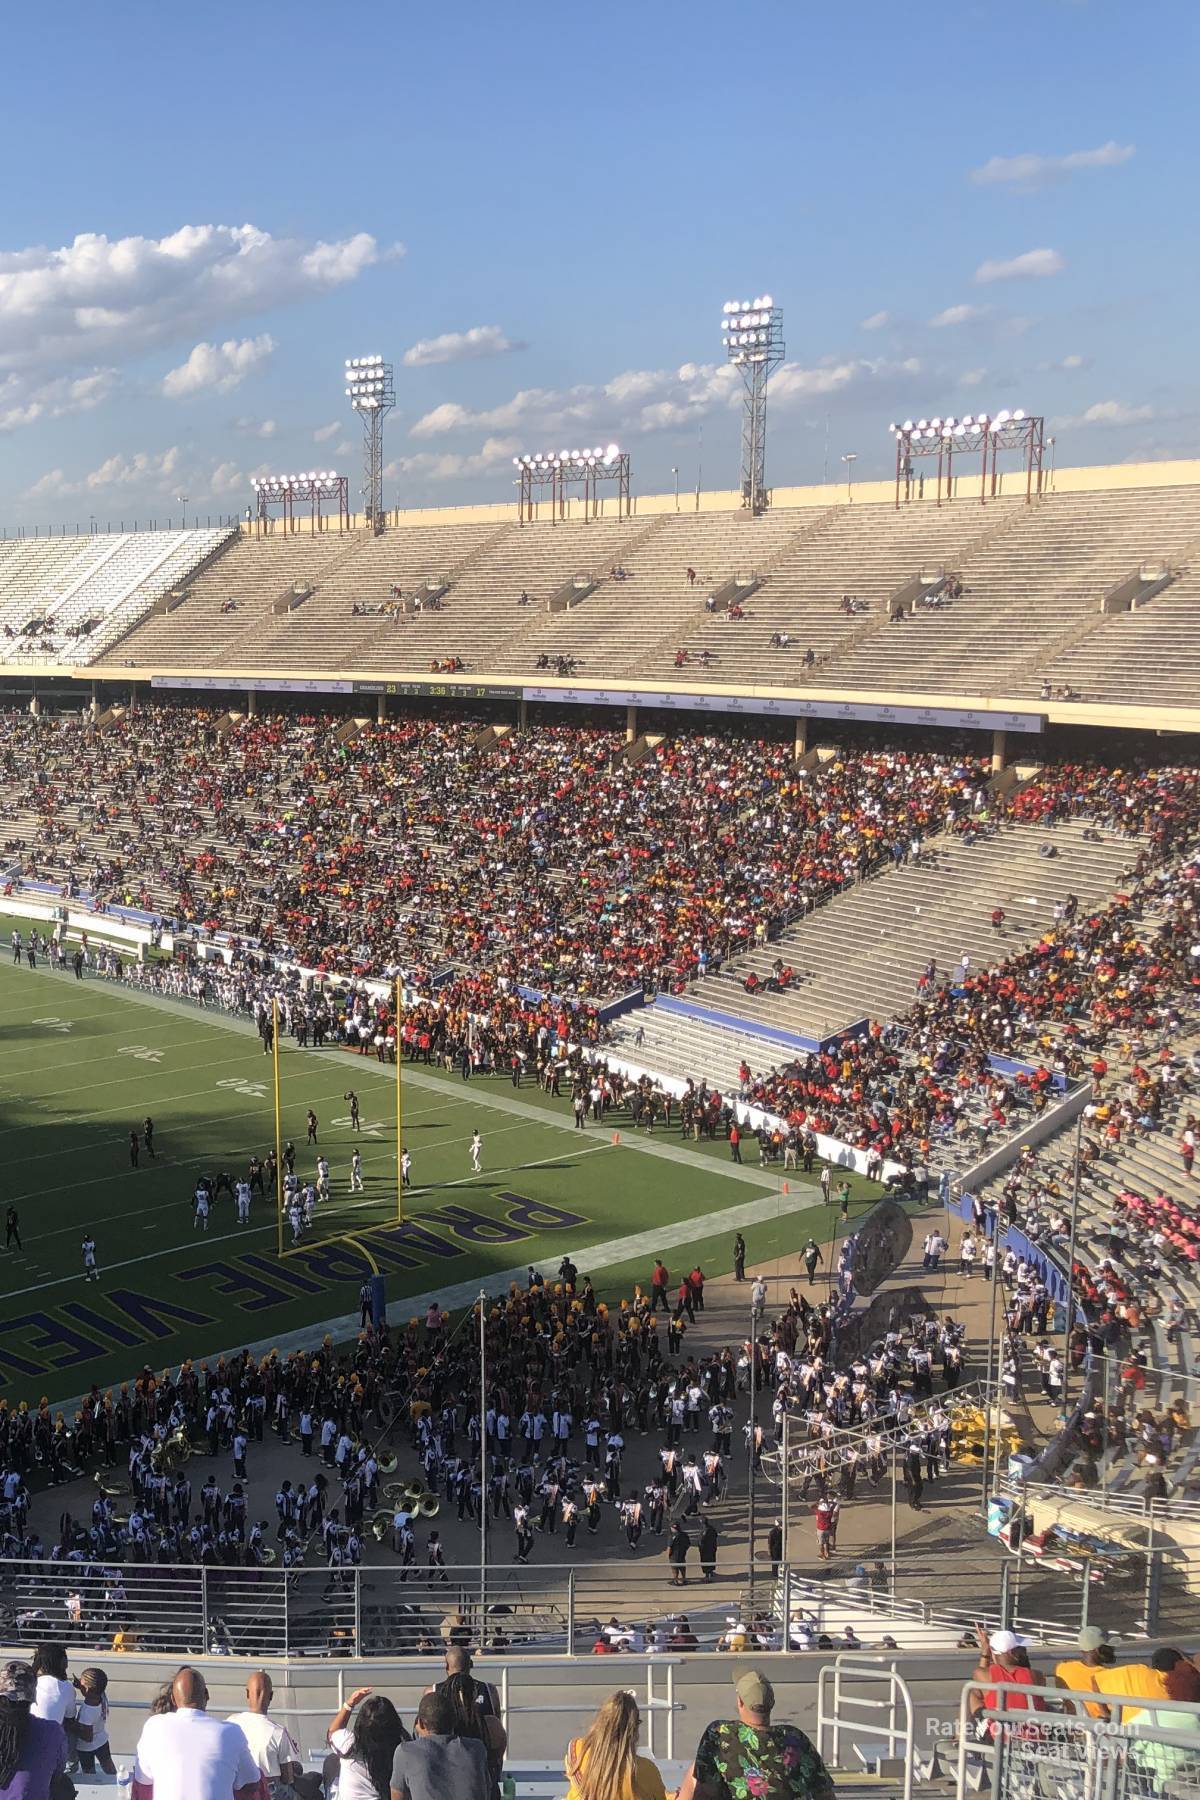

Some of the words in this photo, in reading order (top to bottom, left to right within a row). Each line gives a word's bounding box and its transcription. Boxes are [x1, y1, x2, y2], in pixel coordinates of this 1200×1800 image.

[386, 685, 397, 693] 23
[429, 686, 446, 695] 3:36
[476, 688, 486, 697] 17
[216, 1078, 270, 1094] 20
[170, 1191, 593, 1311] PRAIRIE
